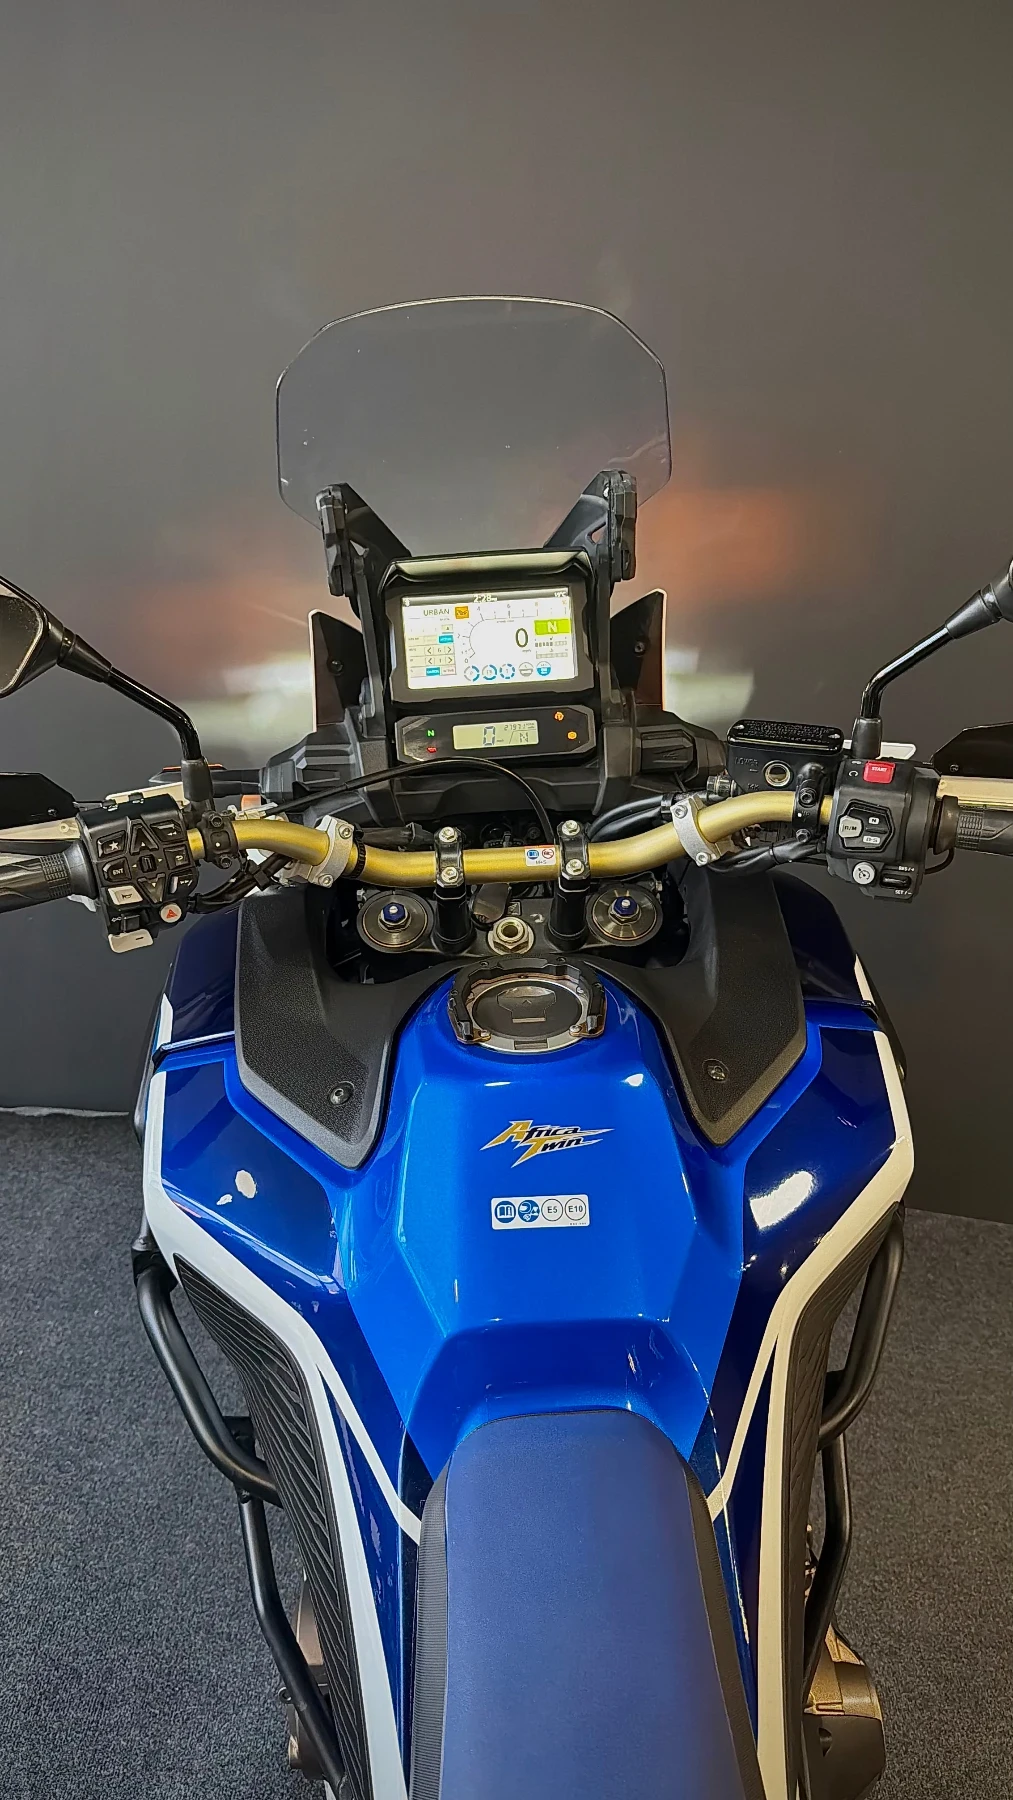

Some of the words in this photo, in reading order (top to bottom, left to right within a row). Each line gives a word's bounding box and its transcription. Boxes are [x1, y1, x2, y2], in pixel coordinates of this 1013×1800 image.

[423, 608, 450, 617] URBAN
[547, 621, 558, 633] N
[515, 628, 529, 648] 0
[483, 726, 496, 746] 0
[113, 868, 124, 876] ENT
[480, 1119, 584, 1151] Africa
[511, 1137, 600, 1168] Twin
[547, 1206, 558, 1214] E5
[568, 1205, 584, 1213] E10
